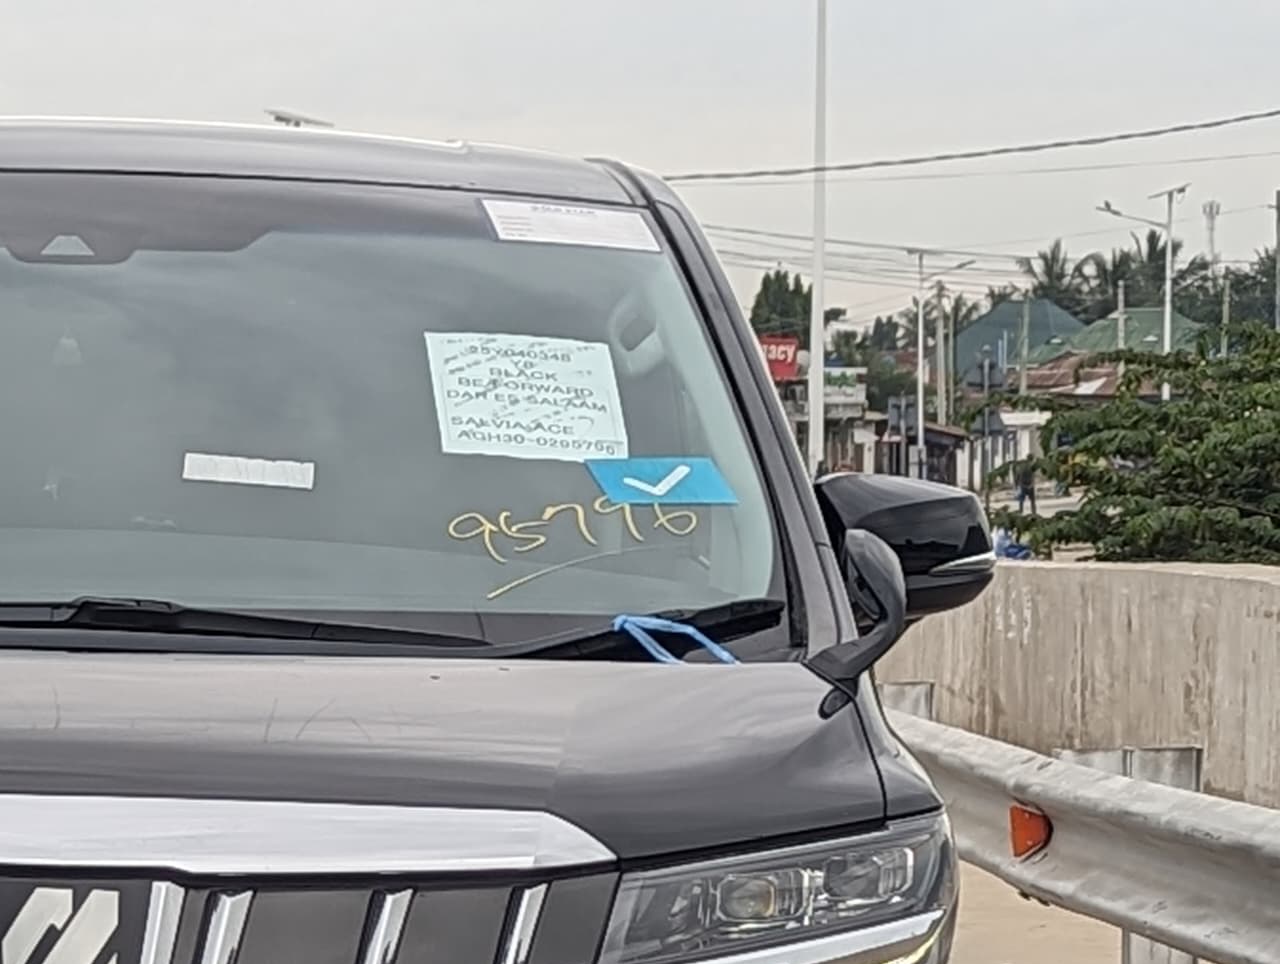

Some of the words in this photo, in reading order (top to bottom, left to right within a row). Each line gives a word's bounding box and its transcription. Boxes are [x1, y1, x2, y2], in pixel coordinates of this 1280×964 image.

[489, 367, 558, 382] BLACK
[446, 389, 488, 401] DAR
[448, 494, 698, 564] 95796
